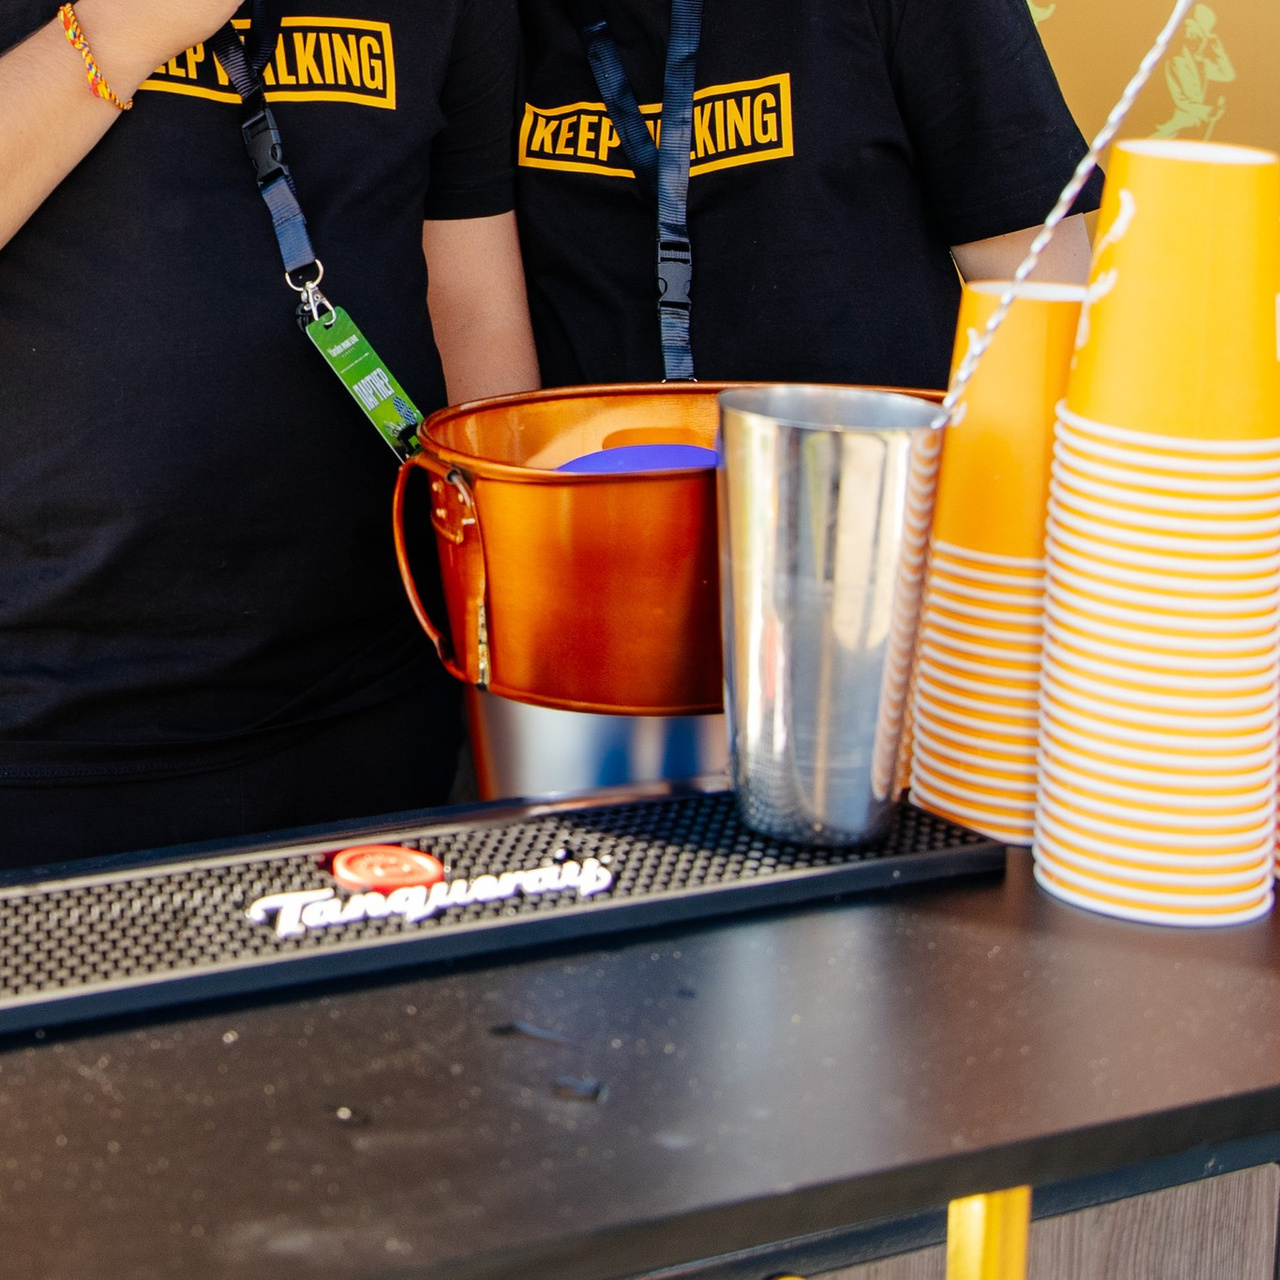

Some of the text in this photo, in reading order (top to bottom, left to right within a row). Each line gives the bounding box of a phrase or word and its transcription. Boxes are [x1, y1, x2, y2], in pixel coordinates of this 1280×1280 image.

[531, 114, 620, 161] KEEP
[352, 367, 395, 411] ПАРТНЕР
[250, 857, 612, 937] Tanqueray
